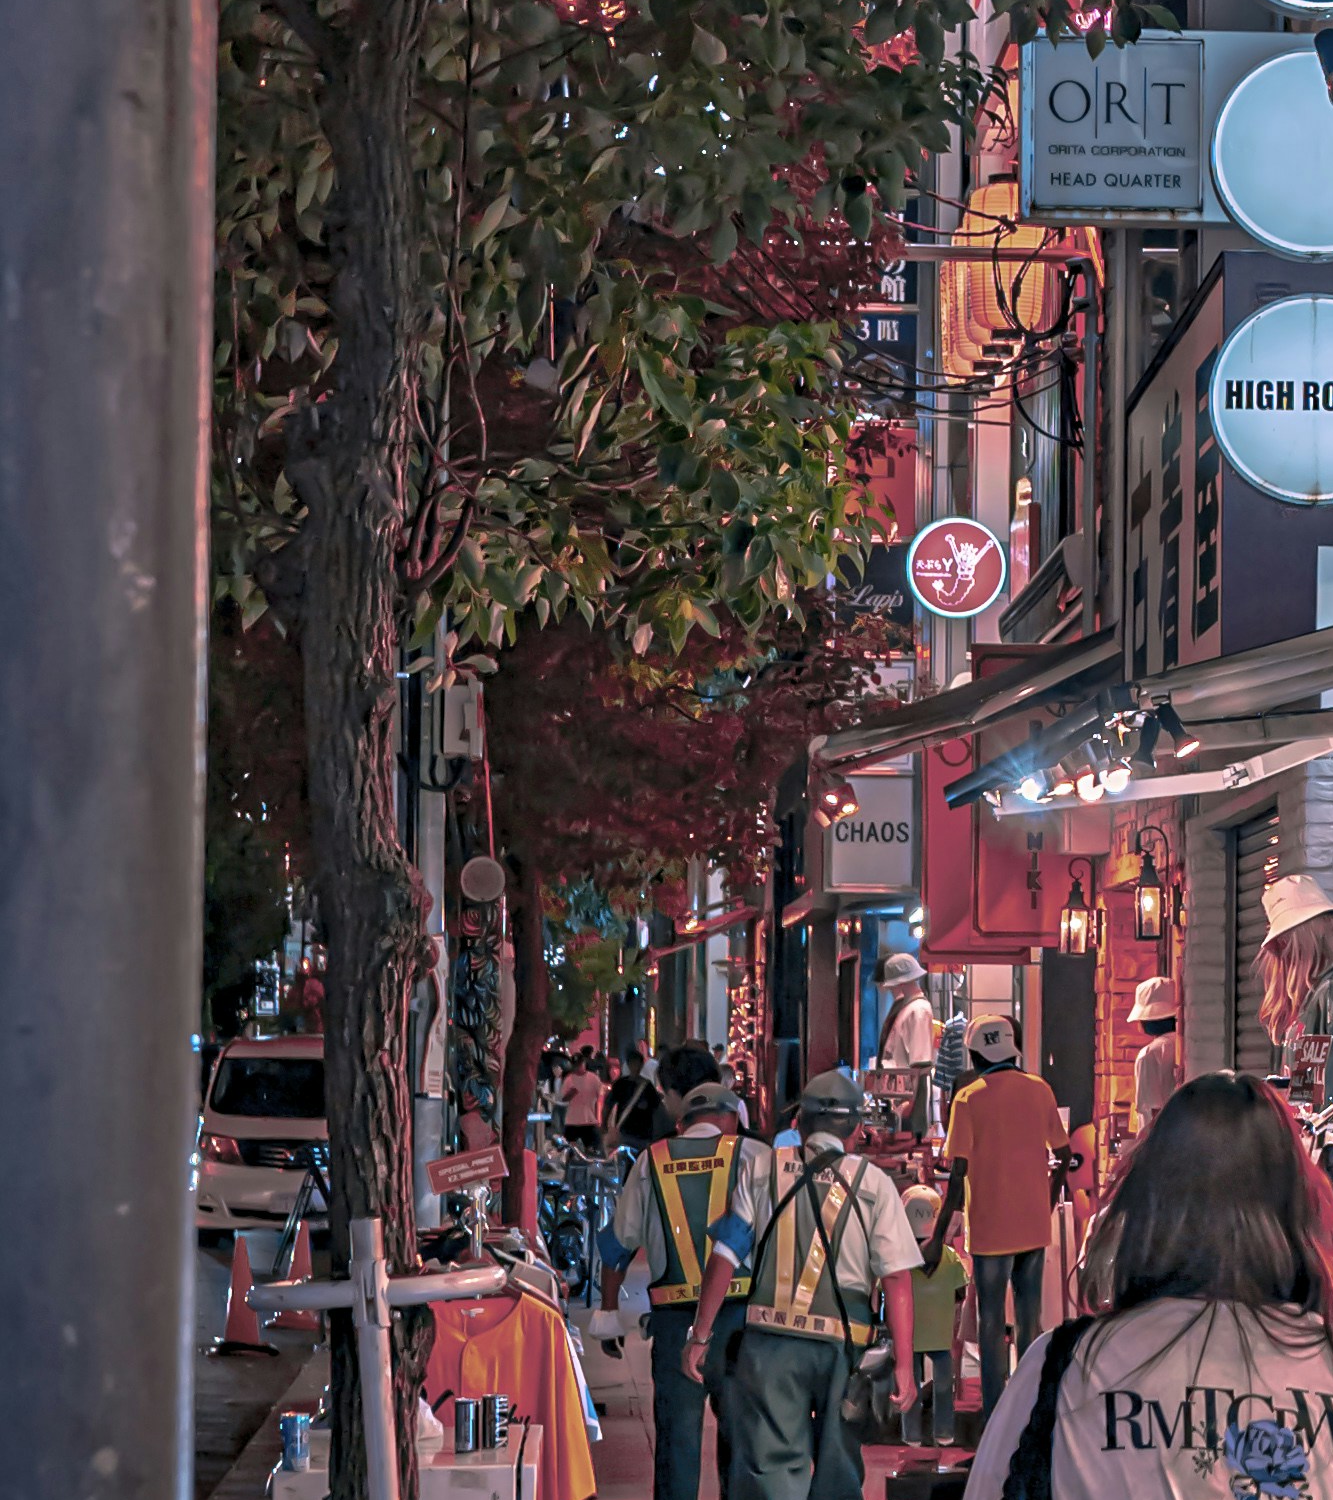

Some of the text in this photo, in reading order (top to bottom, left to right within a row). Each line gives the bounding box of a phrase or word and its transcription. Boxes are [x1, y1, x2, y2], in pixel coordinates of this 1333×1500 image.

[1049, 144, 1186, 158] ORITA CORPORATION
[1050, 172, 1182, 190] HEAD QUARTER
[1224, 379, 1295, 412] HIGH
[849, 586, 903, 611] Lapis
[834, 821, 910, 844] CHAOS
